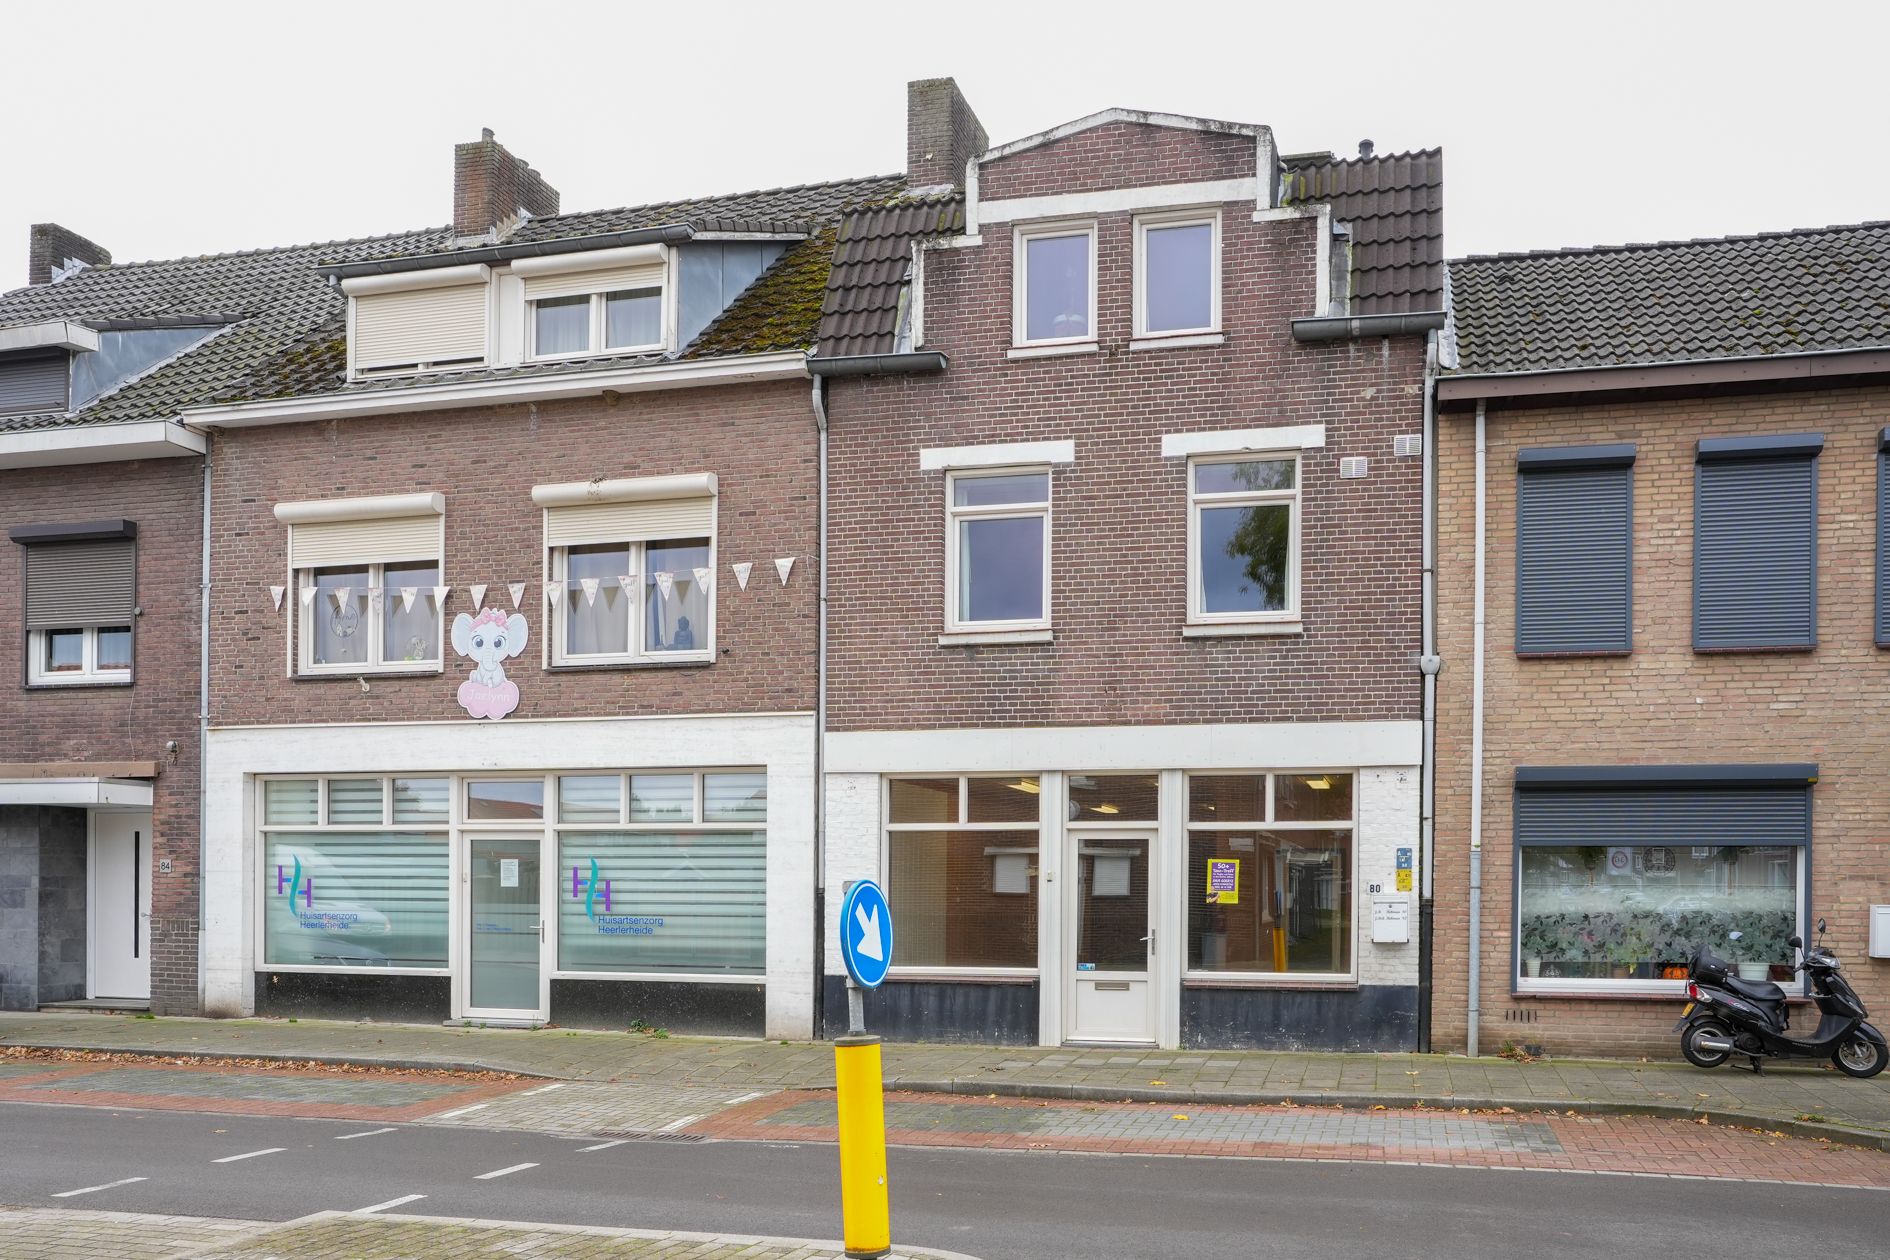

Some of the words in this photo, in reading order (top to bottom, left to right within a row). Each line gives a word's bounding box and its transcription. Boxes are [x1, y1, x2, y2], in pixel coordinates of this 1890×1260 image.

[160, 861, 170, 871] 84
[1369, 884, 1381, 893] 80
[300, 911, 358, 922] Huisartsenzorg
[598, 915, 664, 927] Huisartsenzorg
[300, 920, 349, 929] Heerlerheide
[598, 925, 654, 934] Heerlerheide
